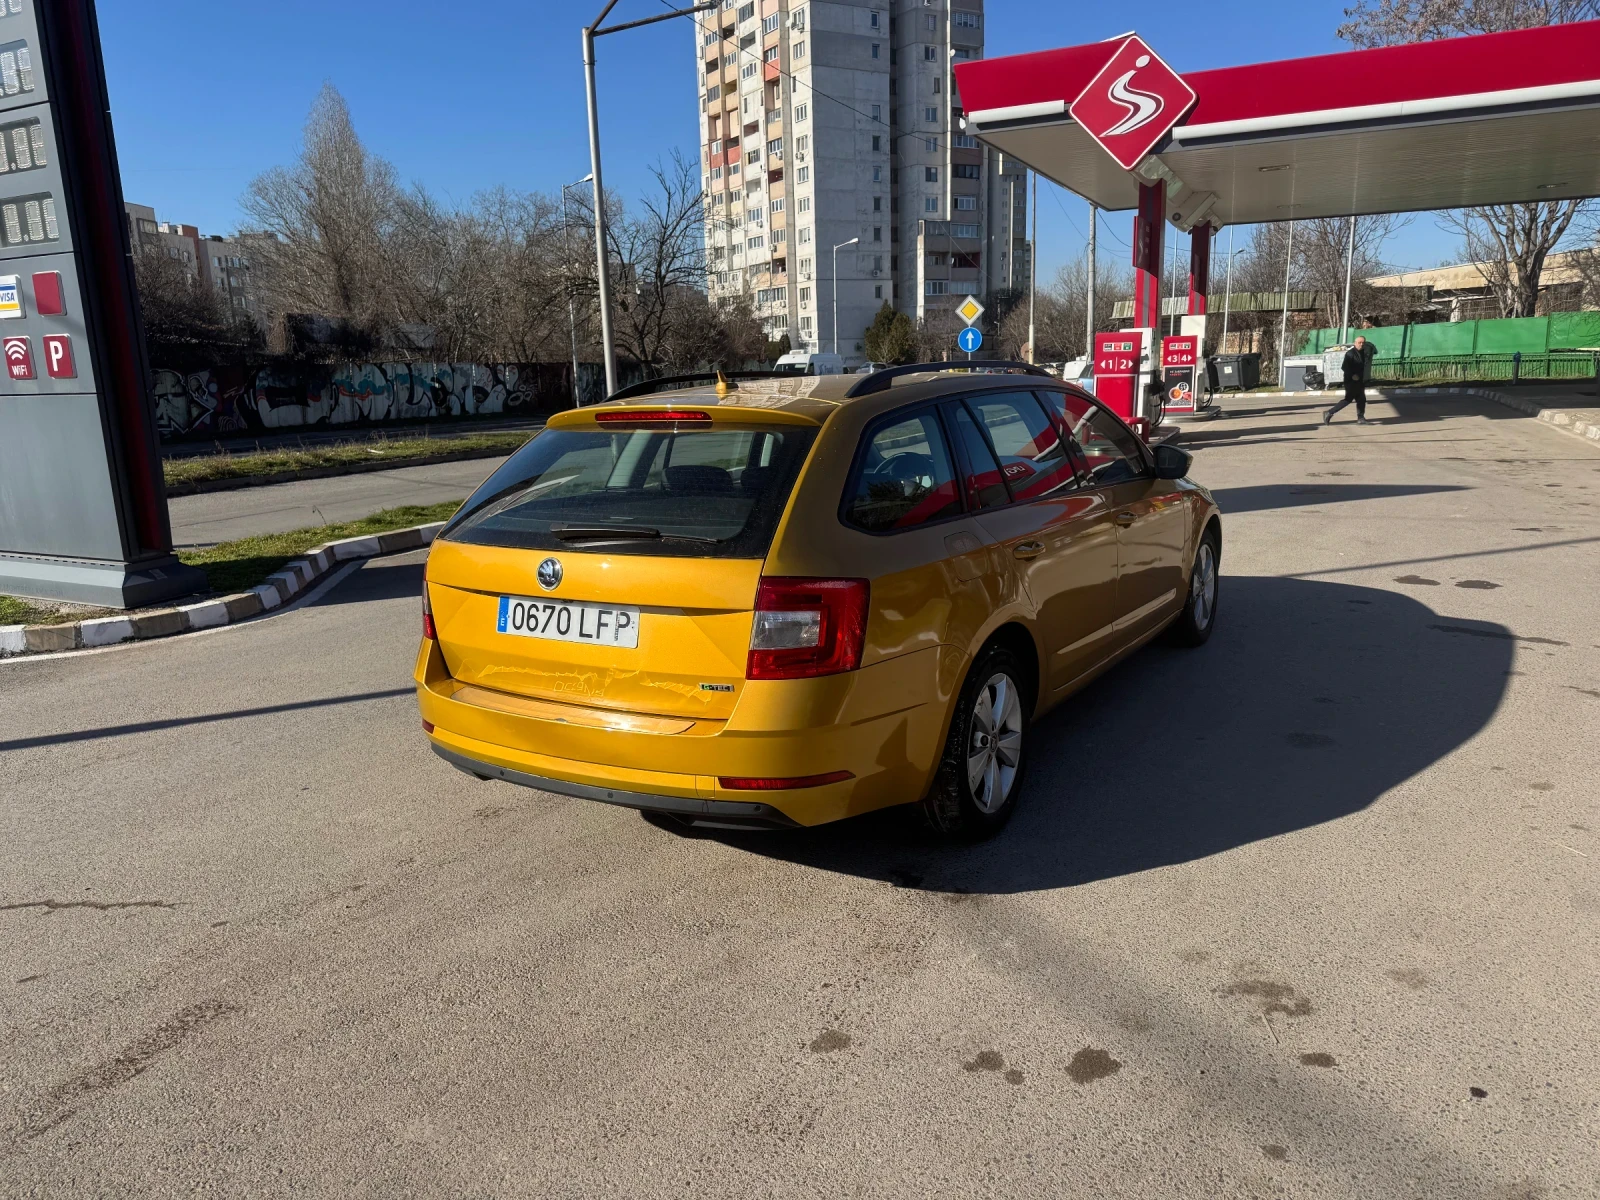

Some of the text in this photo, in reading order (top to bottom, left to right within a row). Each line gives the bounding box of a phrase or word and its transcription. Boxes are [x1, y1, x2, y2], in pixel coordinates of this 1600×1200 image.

[0, 292, 15, 302] VISA
[49, 341, 63, 372] P
[1172, 354, 1187, 363] 3 4
[1107, 359, 1127, 370] 1 2
[11, 365, 28, 376] WiFi
[512, 602, 572, 636] 0670
[578, 608, 631, 641] LFP
